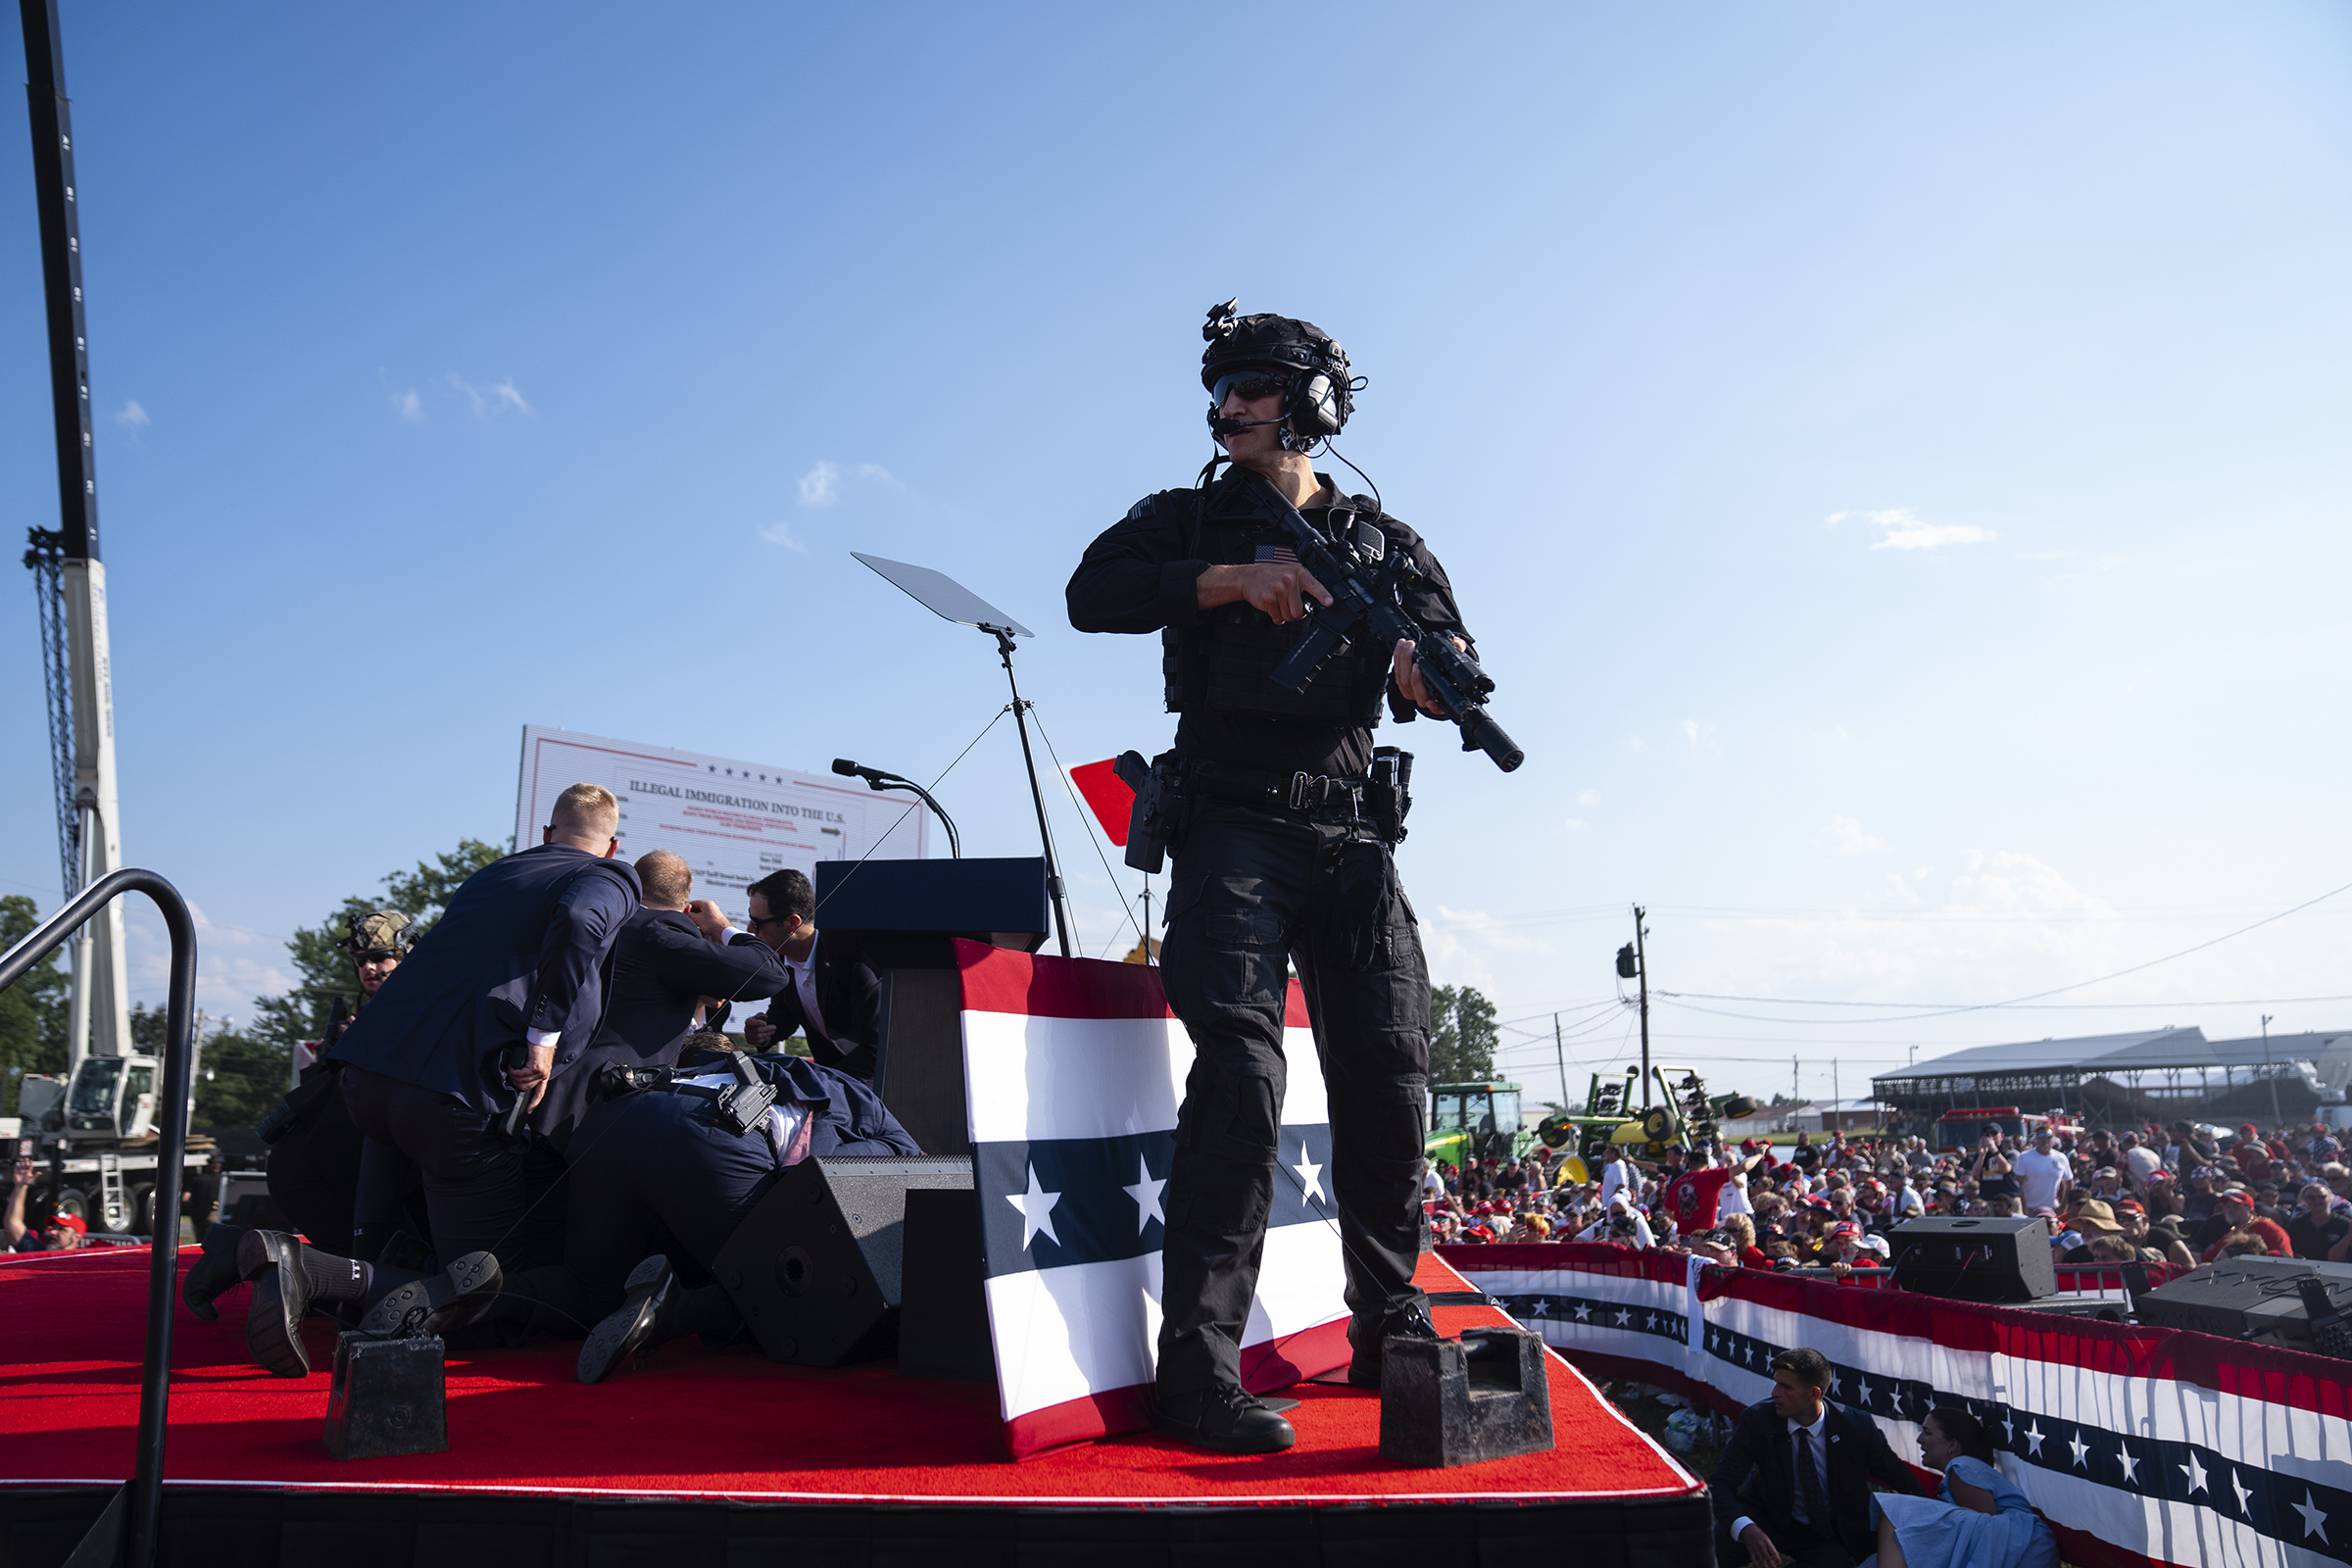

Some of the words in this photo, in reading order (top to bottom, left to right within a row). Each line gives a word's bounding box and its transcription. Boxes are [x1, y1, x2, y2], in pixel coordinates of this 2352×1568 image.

[630, 780, 682, 799] ILLEGAL
[685, 788, 768, 811] IMMIGRATION
[771, 803, 799, 816] INTO
[802, 807, 824, 820] THE
[826, 811, 846, 824] U.S.
[1778, 1256, 1799, 1265] TRUMP
